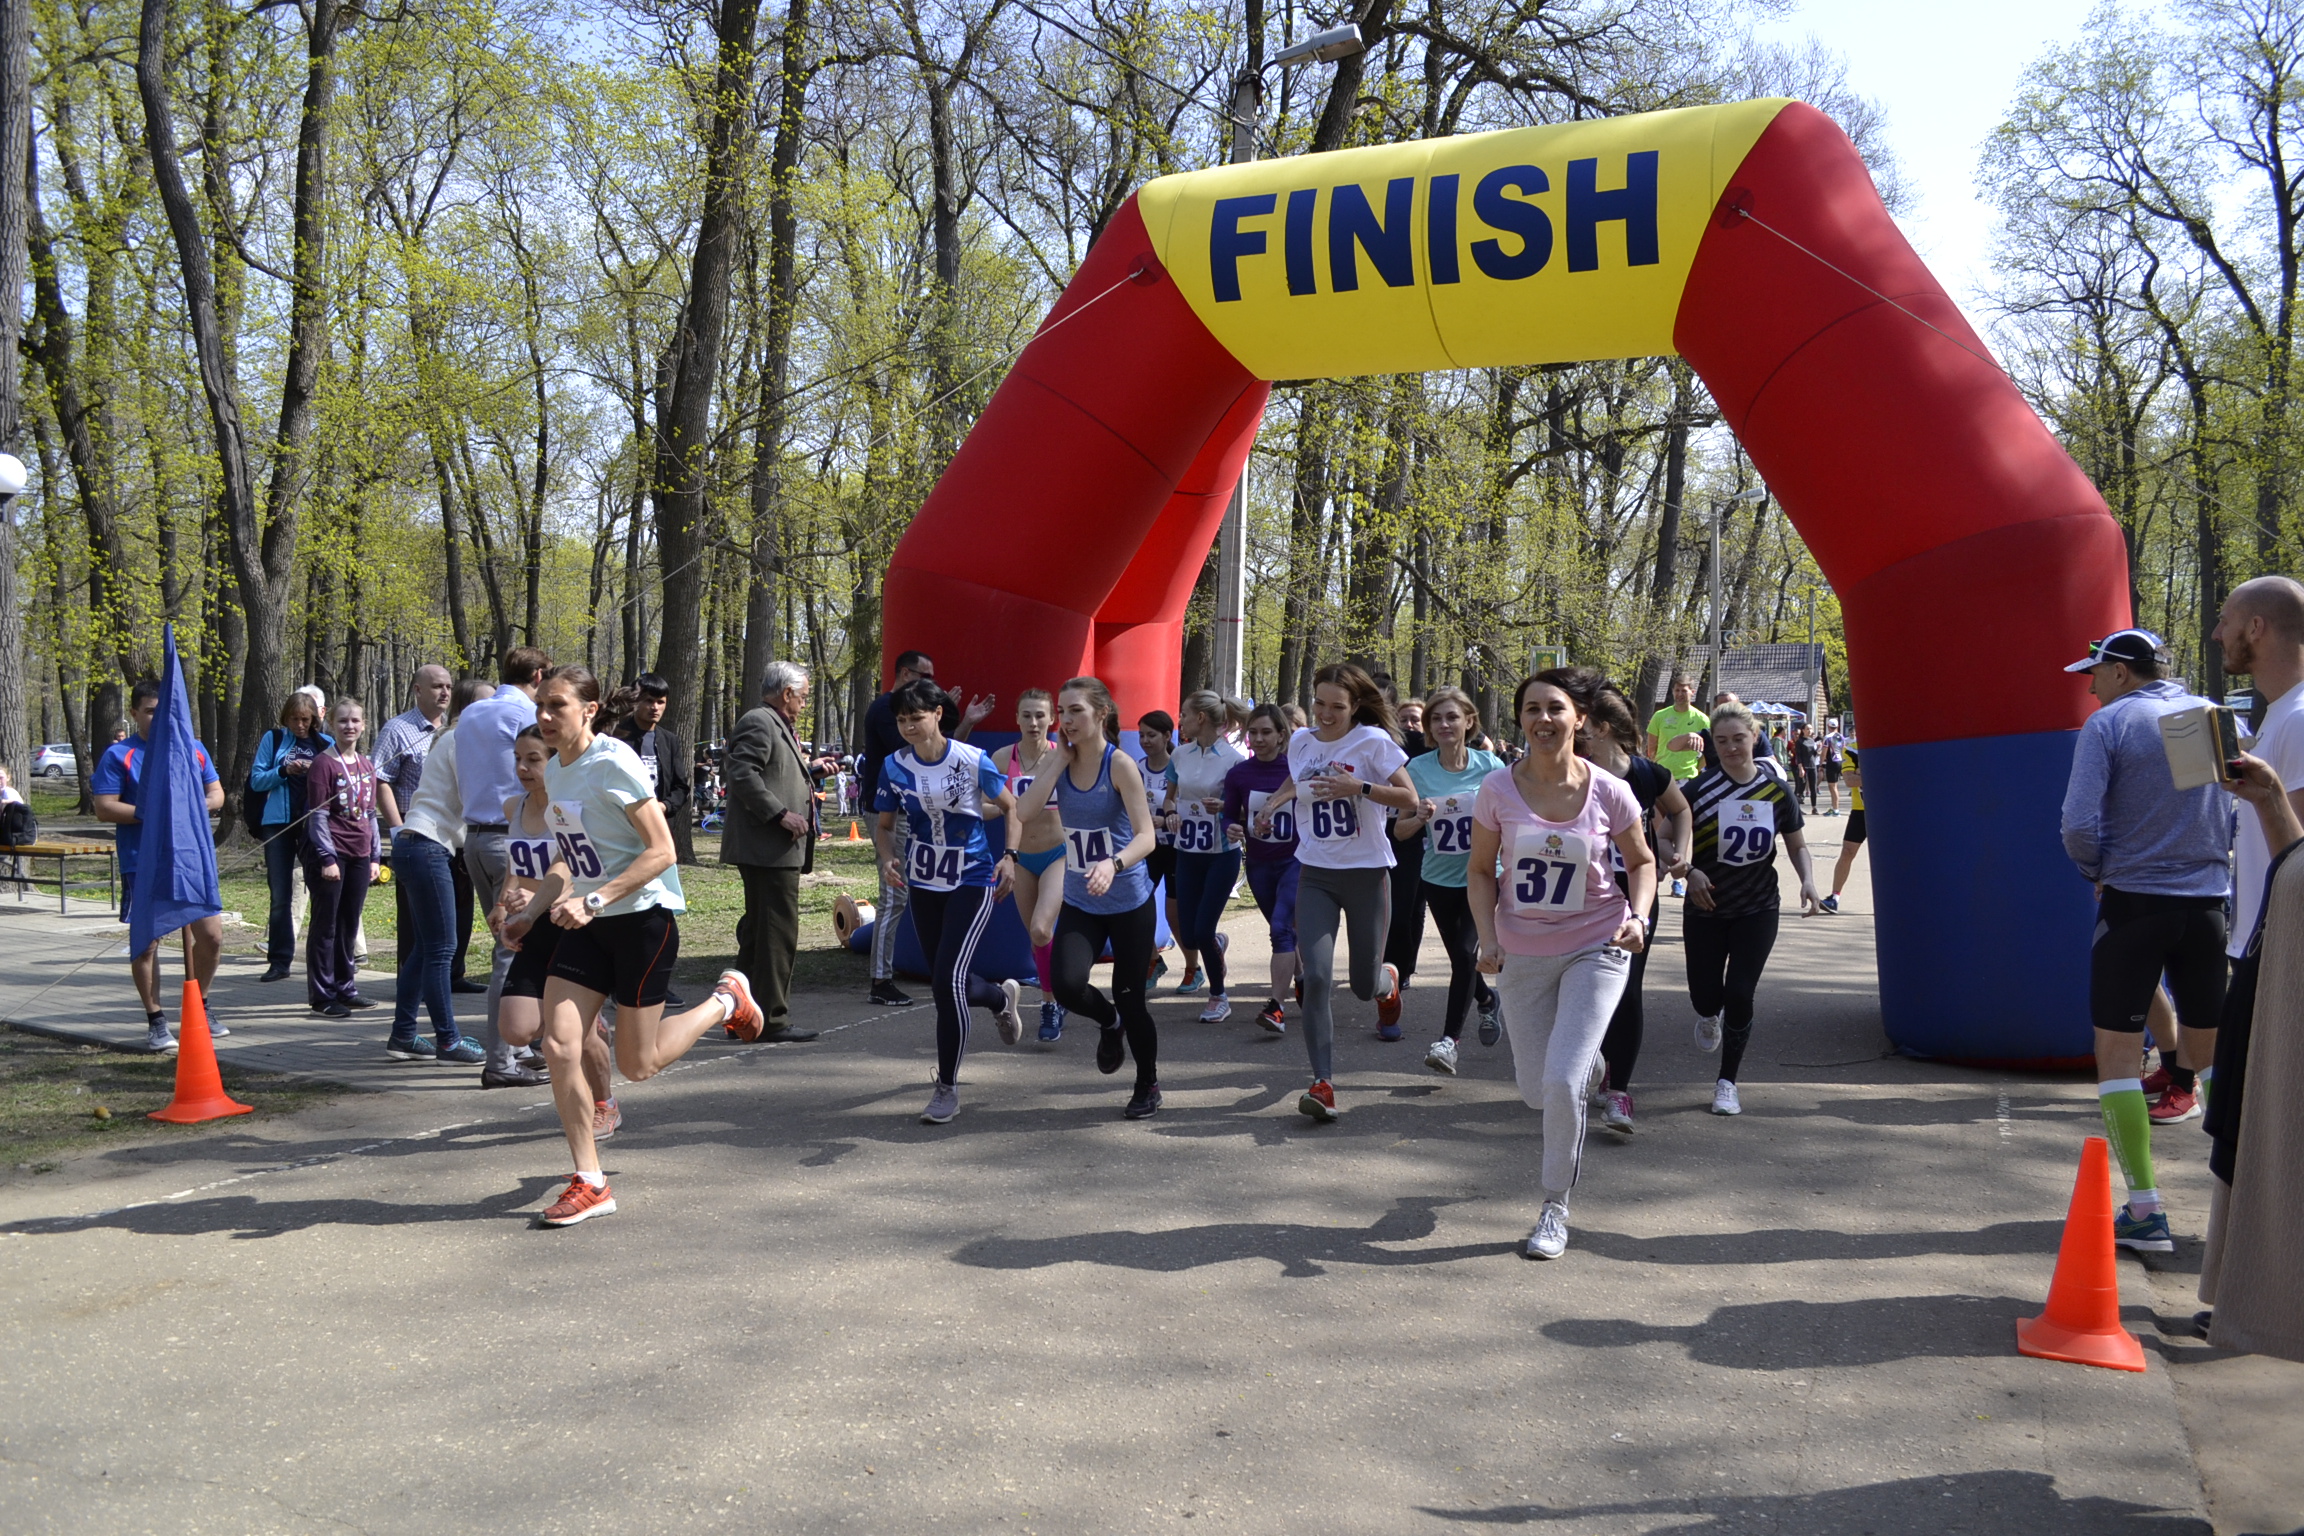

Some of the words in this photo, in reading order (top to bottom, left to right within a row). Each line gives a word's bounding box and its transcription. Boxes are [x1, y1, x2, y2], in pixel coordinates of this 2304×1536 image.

[1210, 150, 1660, 303] FINISH
[947, 772, 966, 785] PNZ
[950, 786, 965, 797] RUN
[1179, 819, 1213, 850] 93
[1312, 799, 1355, 838] 69
[1434, 816, 1473, 852] 28
[510, 841, 550, 880] 91
[556, 831, 601, 878] 85
[1069, 830, 1109, 869] 14
[1723, 825, 1772, 863] 29
[915, 844, 960, 886] 94
[1516, 858, 1576, 905] 37
